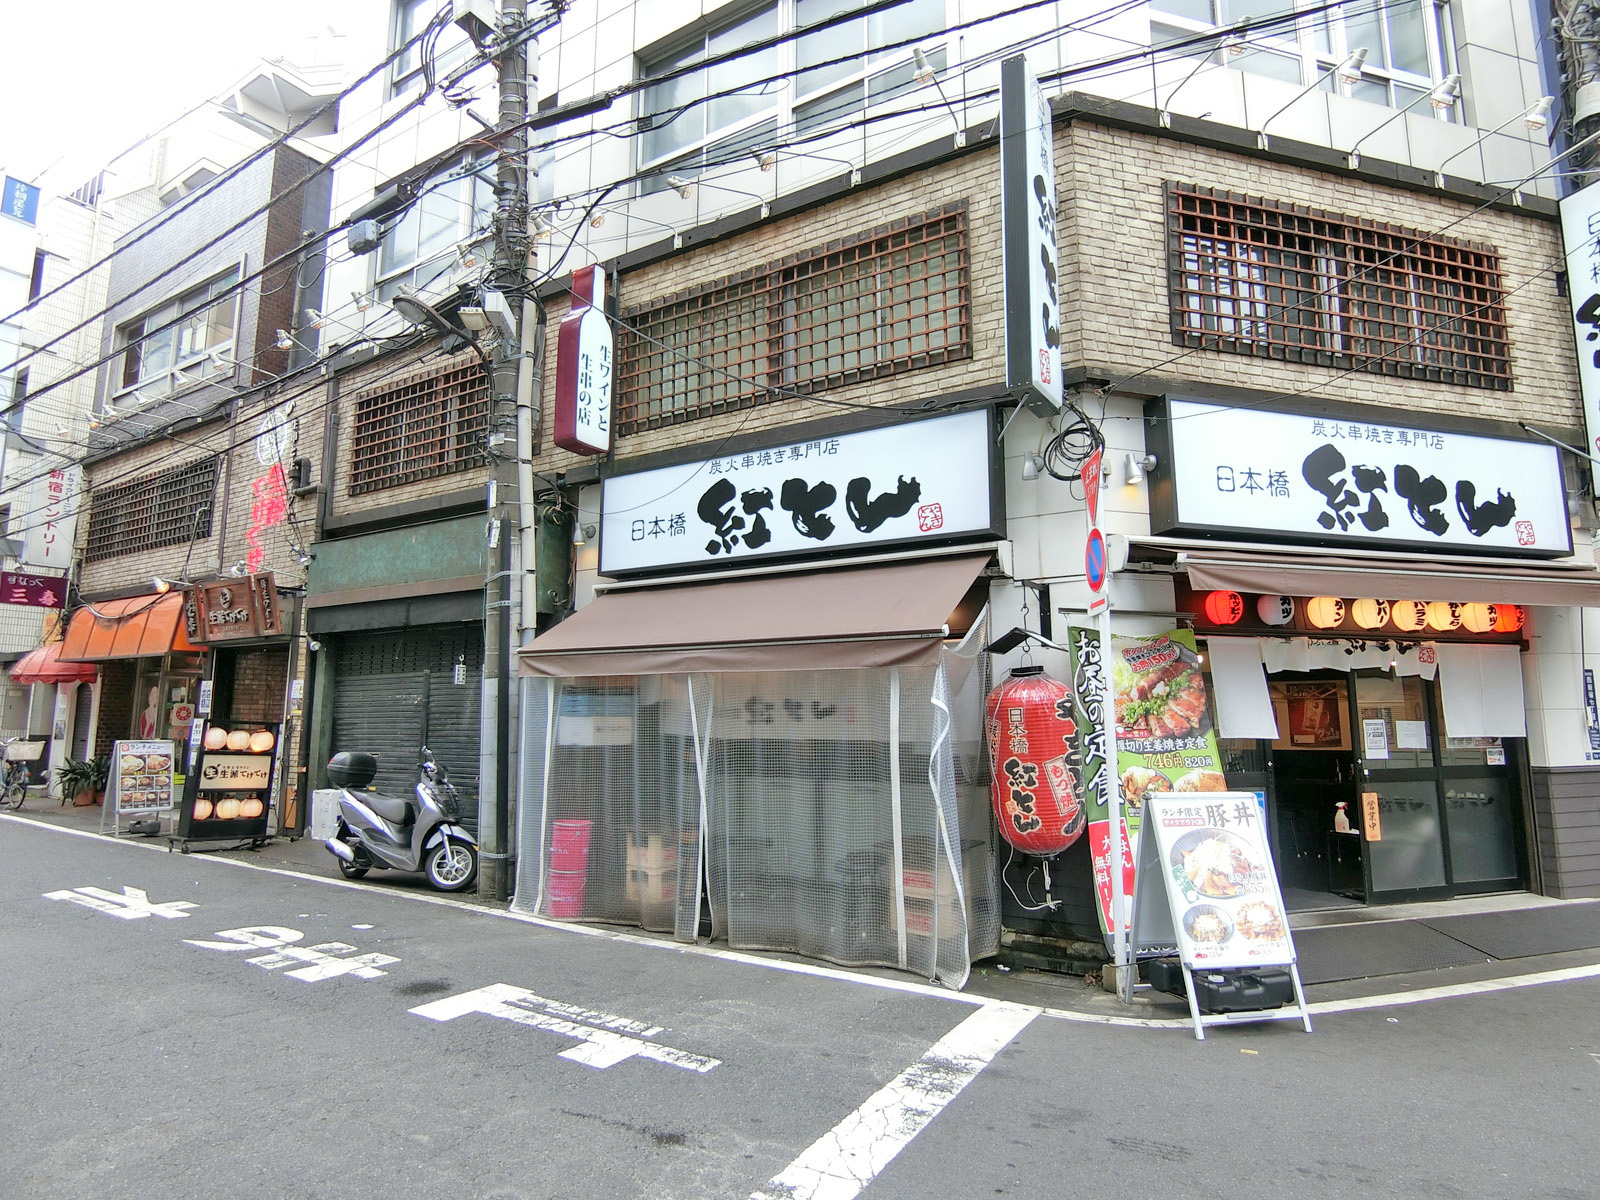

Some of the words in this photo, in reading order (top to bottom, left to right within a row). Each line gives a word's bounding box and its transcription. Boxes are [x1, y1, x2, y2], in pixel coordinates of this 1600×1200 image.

[578, 353, 593, 426] 生串の店
[598, 346, 612, 431] 生ワインと
[1311, 420, 1445, 450] 炭火串焼き専門店
[708, 439, 840, 475] 炭火串焼き専門店
[1216, 466, 1290, 498] 日本橋
[1302, 443, 1516, 537] 紅とん
[44, 469, 65, 557] 新宿ランドリー
[631, 513, 686, 541] 日本橋
[698, 474, 921, 555] 紅とん
[1229, 594, 1240, 620] ホッピー
[1329, 600, 1343, 623] タン
[1414, 601, 1426, 626] ハラミ
[1449, 602, 1461, 627] かしら
[1008, 707, 1028, 754] 日本橋
[1004, 757, 1042, 834] 紅とん
[1161, 803, 1203, 817] ランチ限定
[1205, 801, 1255, 828] 豚丼
[1367, 800, 1377, 831] 営業中
